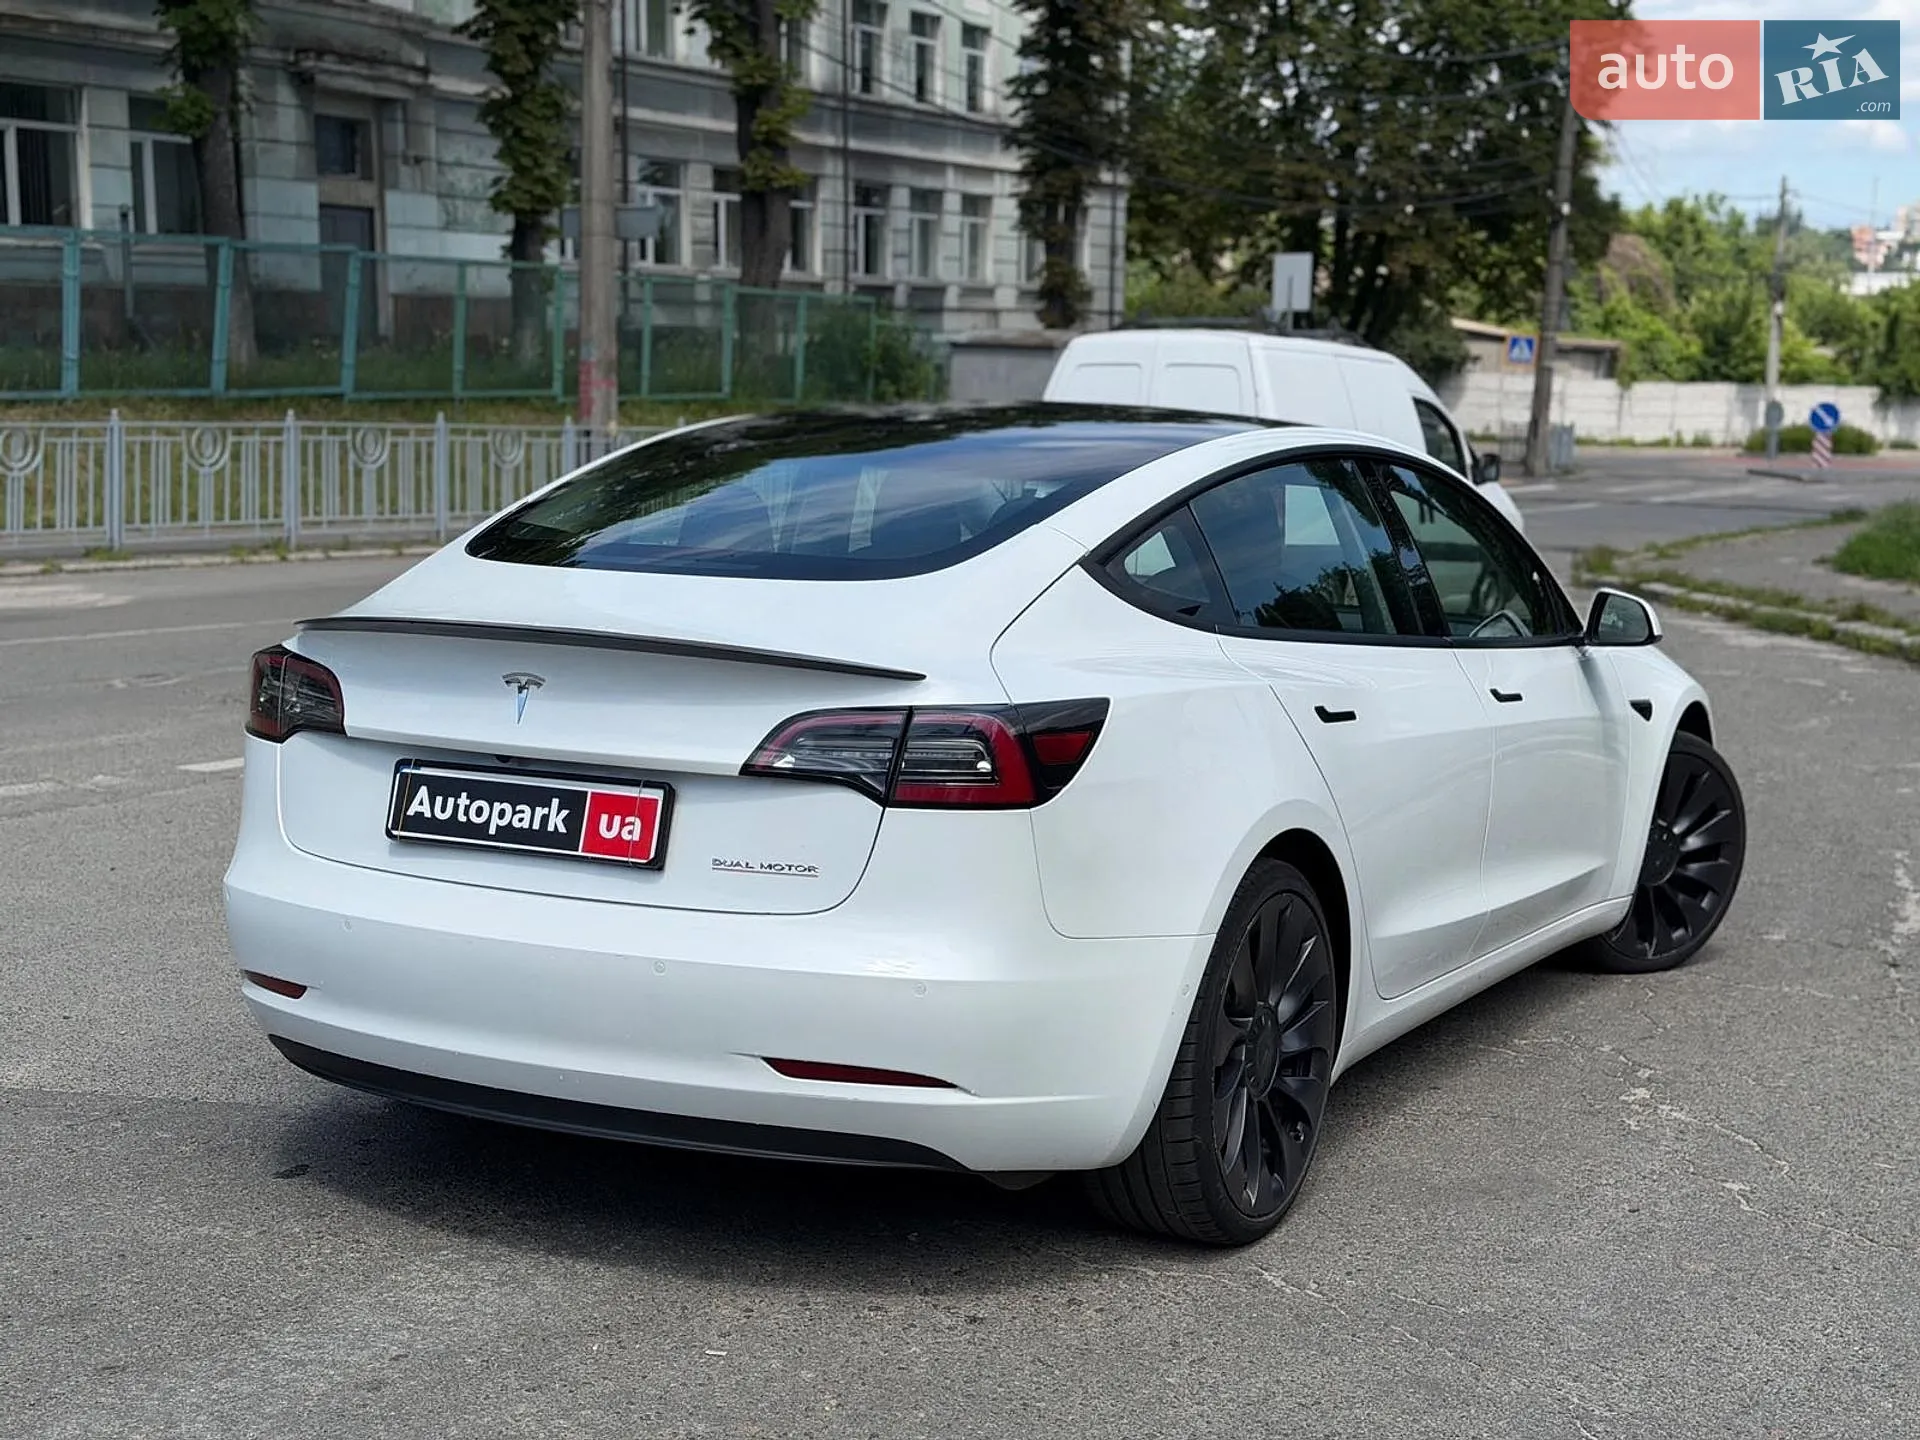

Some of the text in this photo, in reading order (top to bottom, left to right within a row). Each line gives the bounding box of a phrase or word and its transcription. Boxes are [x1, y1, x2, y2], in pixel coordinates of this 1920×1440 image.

[406, 785, 641, 842] Autopark ua
[711, 858, 819, 874] DUAL MOTOR
